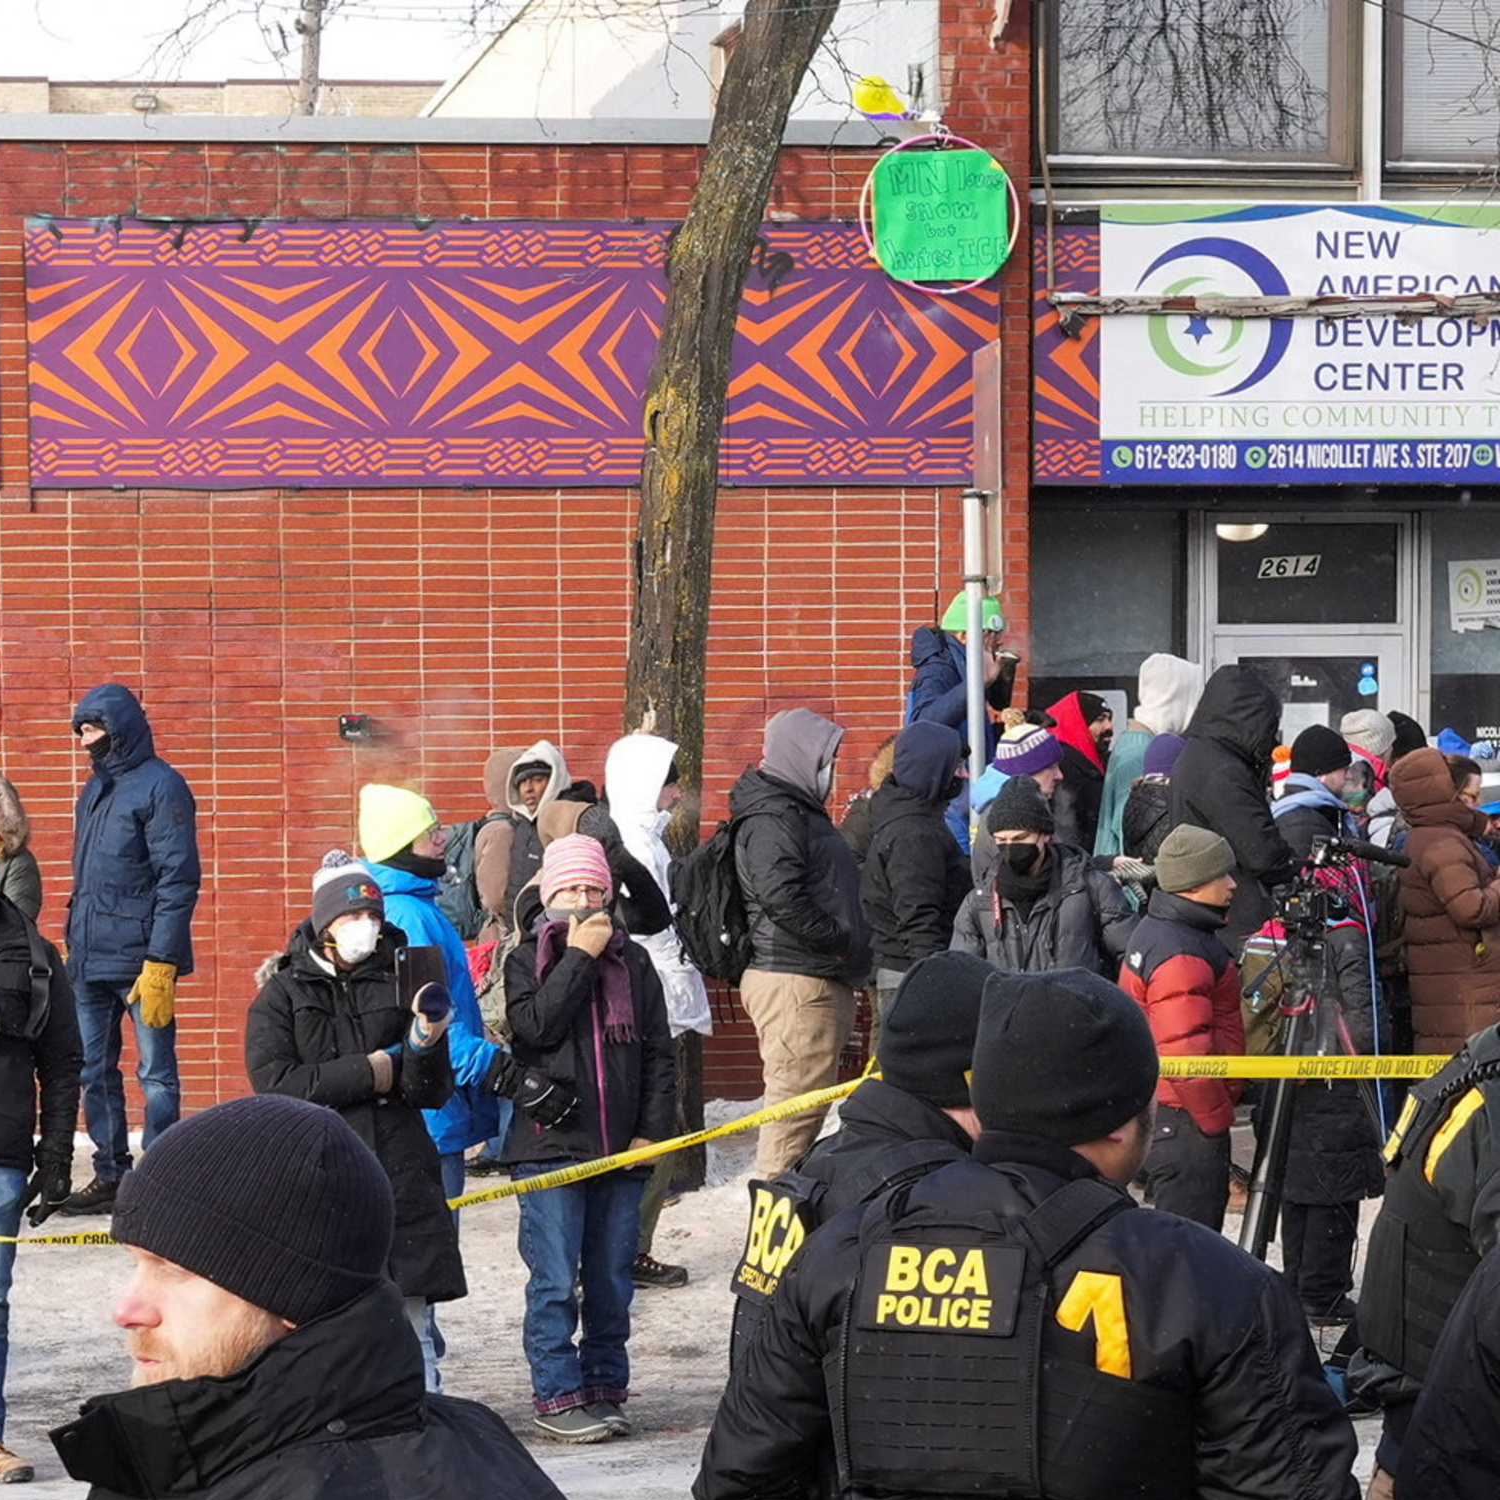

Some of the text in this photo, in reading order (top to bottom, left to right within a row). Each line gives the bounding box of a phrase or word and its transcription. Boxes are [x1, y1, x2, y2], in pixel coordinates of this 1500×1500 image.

[888, 160, 949, 197] MN
[924, 222, 958, 239] but
[1316, 230, 1401, 260] NEW
[1313, 362, 1465, 392] CENTER
[1138, 404, 1270, 429] HELPING
[1282, 404, 1472, 429] COMMUNITY
[1134, 443, 1238, 470] 612-823-0180
[1267, 443, 1305, 469] 2614
[1306, 442, 1371, 469] NICOLLET
[1372, 443, 1399, 469] AVE
[1400, 443, 1414, 469] S.
[1416, 443, 1442, 469] STE
[1444, 443, 1473, 469] 207
[1261, 557, 1319, 578] 2614
[83, 1232, 121, 1246] CRO
[745, 1187, 805, 1279] BCA
[885, 1245, 989, 1296] BCA
[875, 1293, 993, 1330] POLICE
